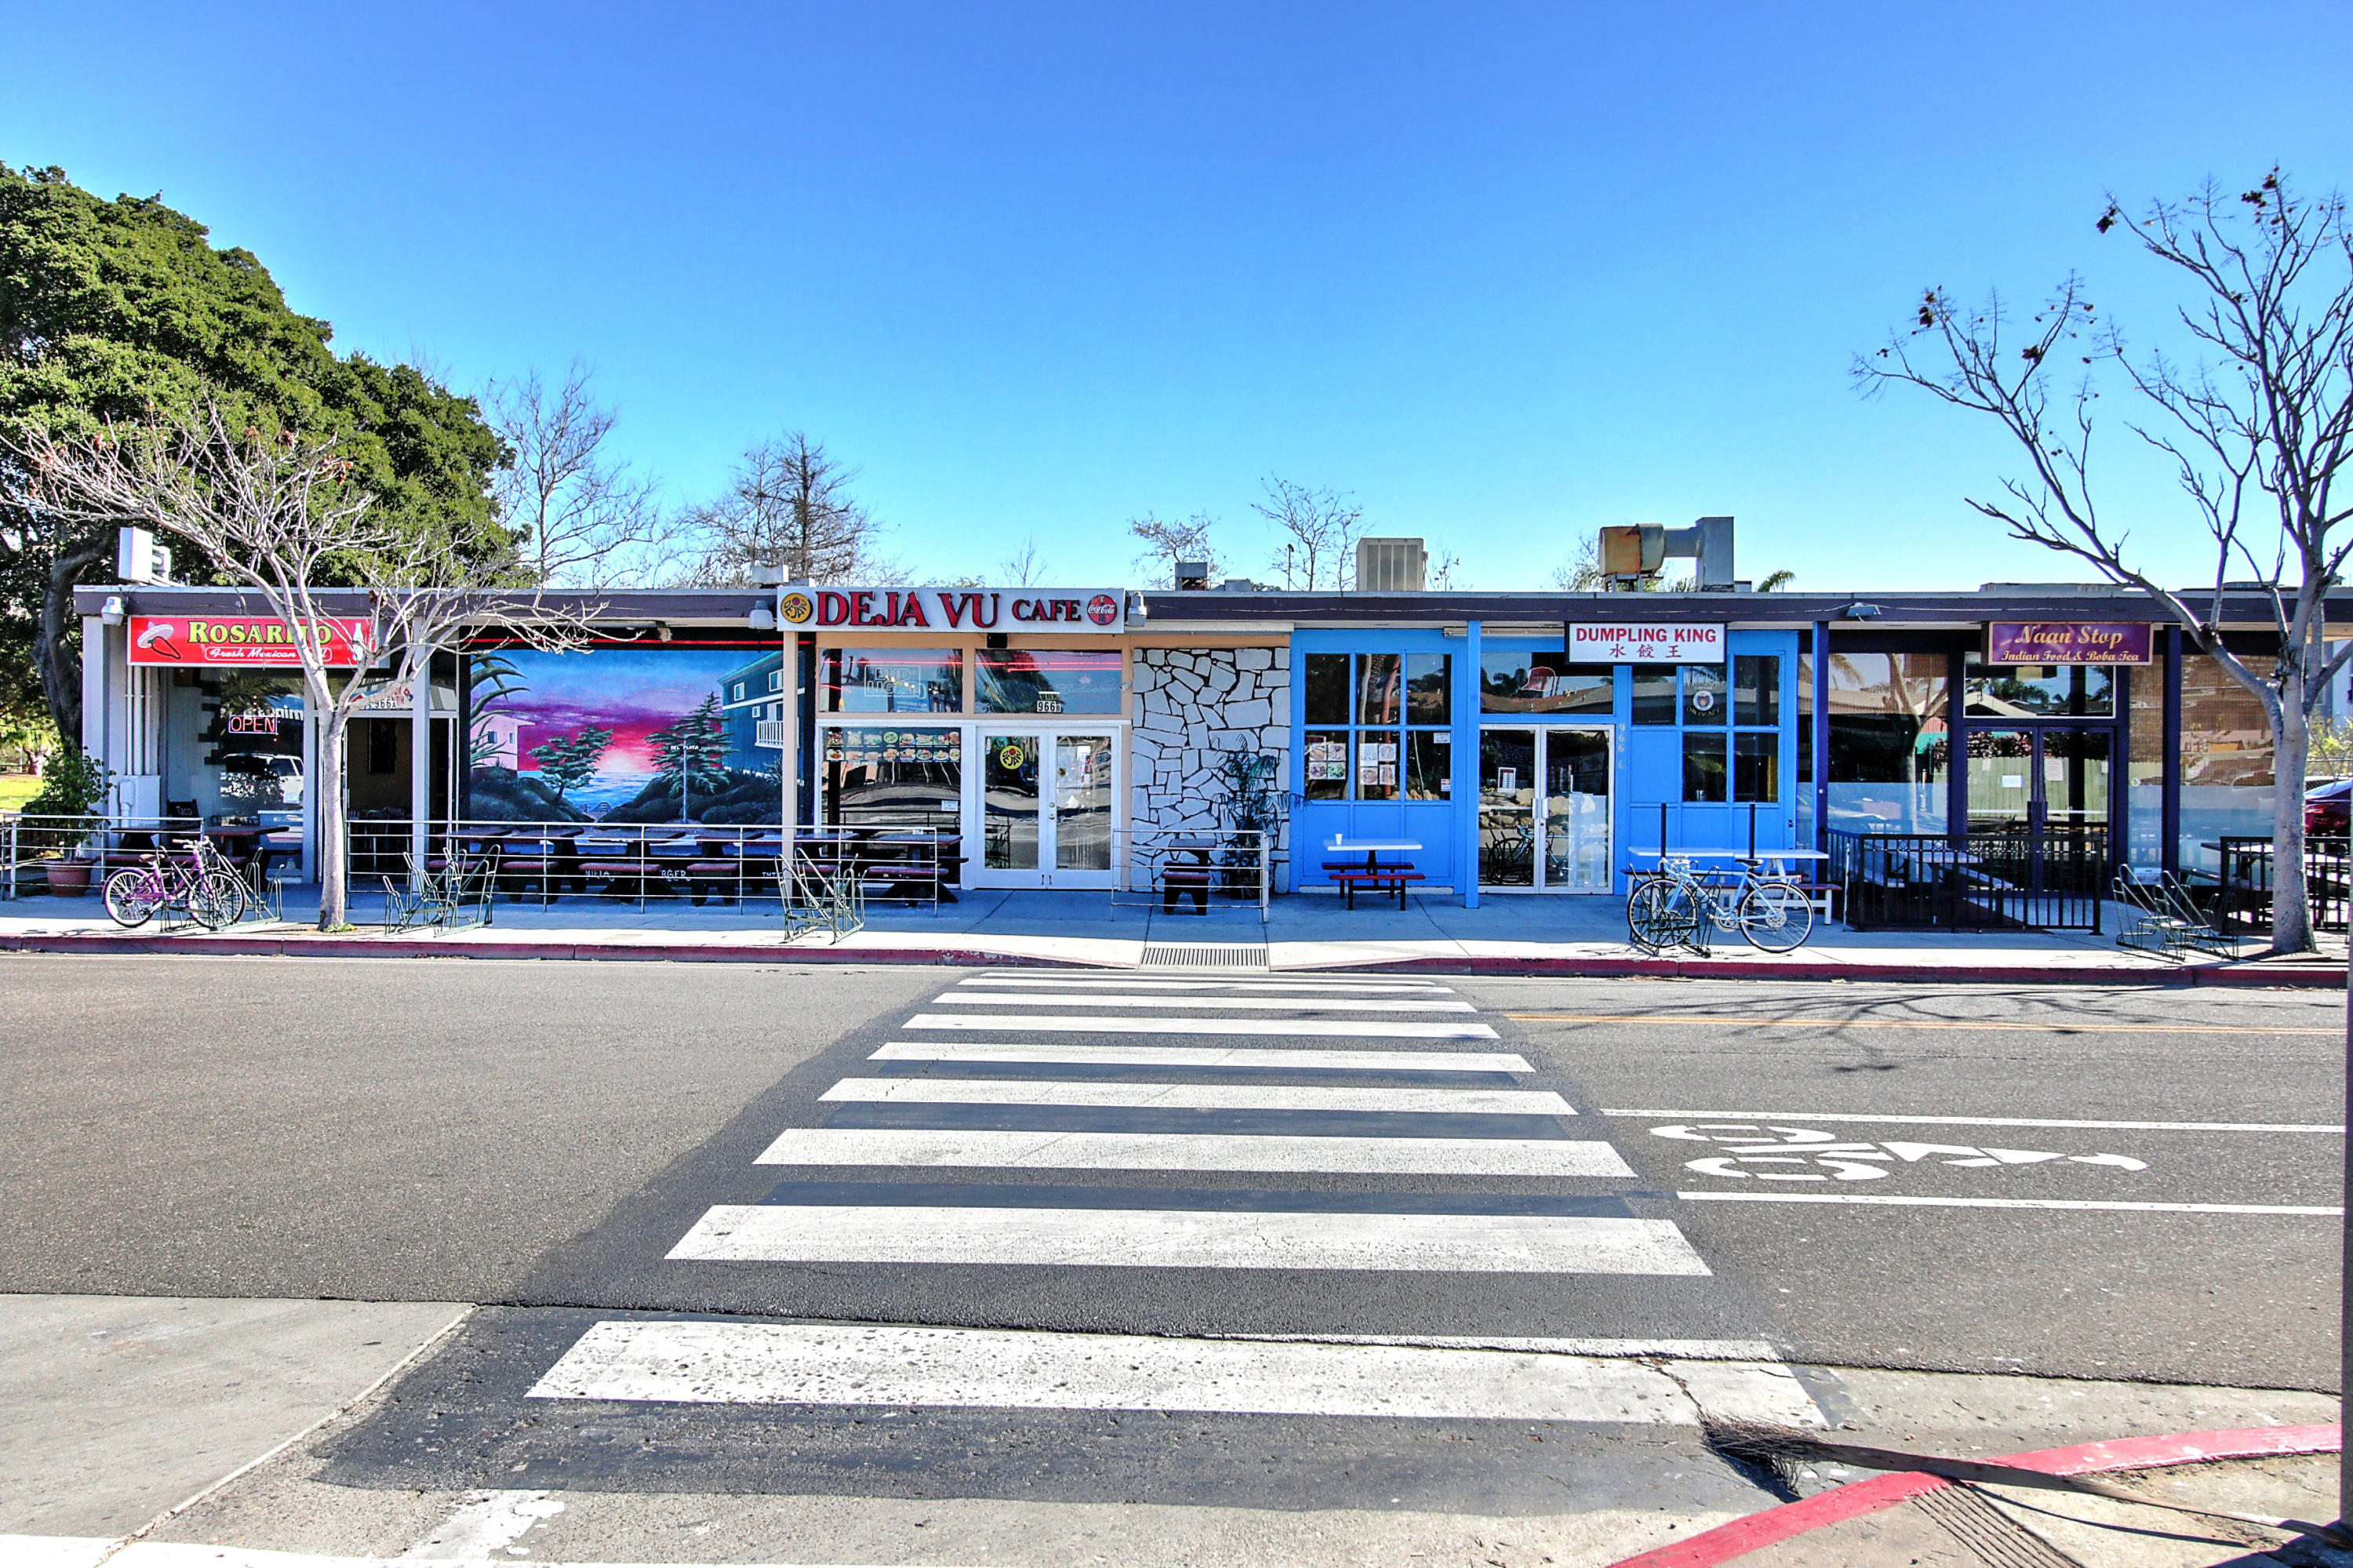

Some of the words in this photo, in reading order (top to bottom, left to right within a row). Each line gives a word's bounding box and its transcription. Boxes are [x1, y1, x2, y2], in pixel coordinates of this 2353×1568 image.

[816, 591, 930, 627] DEJA
[937, 592, 1000, 628] VU
[1012, 598, 1081, 622] CAFE
[1576, 628, 1667, 642] DUMPLING
[1674, 628, 1717, 642] KING
[2014, 624, 2072, 644] Naan
[2078, 625, 2123, 649] Stop
[209, 648, 245, 658] Fresh
[247, 648, 297, 658] Mexican
[2001, 650, 2040, 661] Indian
[2042, 650, 2071, 661] Food
[2073, 650, 2082, 661] &
[2085, 650, 2116, 661] Boba
[2118, 650, 2139, 661] Tea
[231, 716, 275, 733] OPEN
